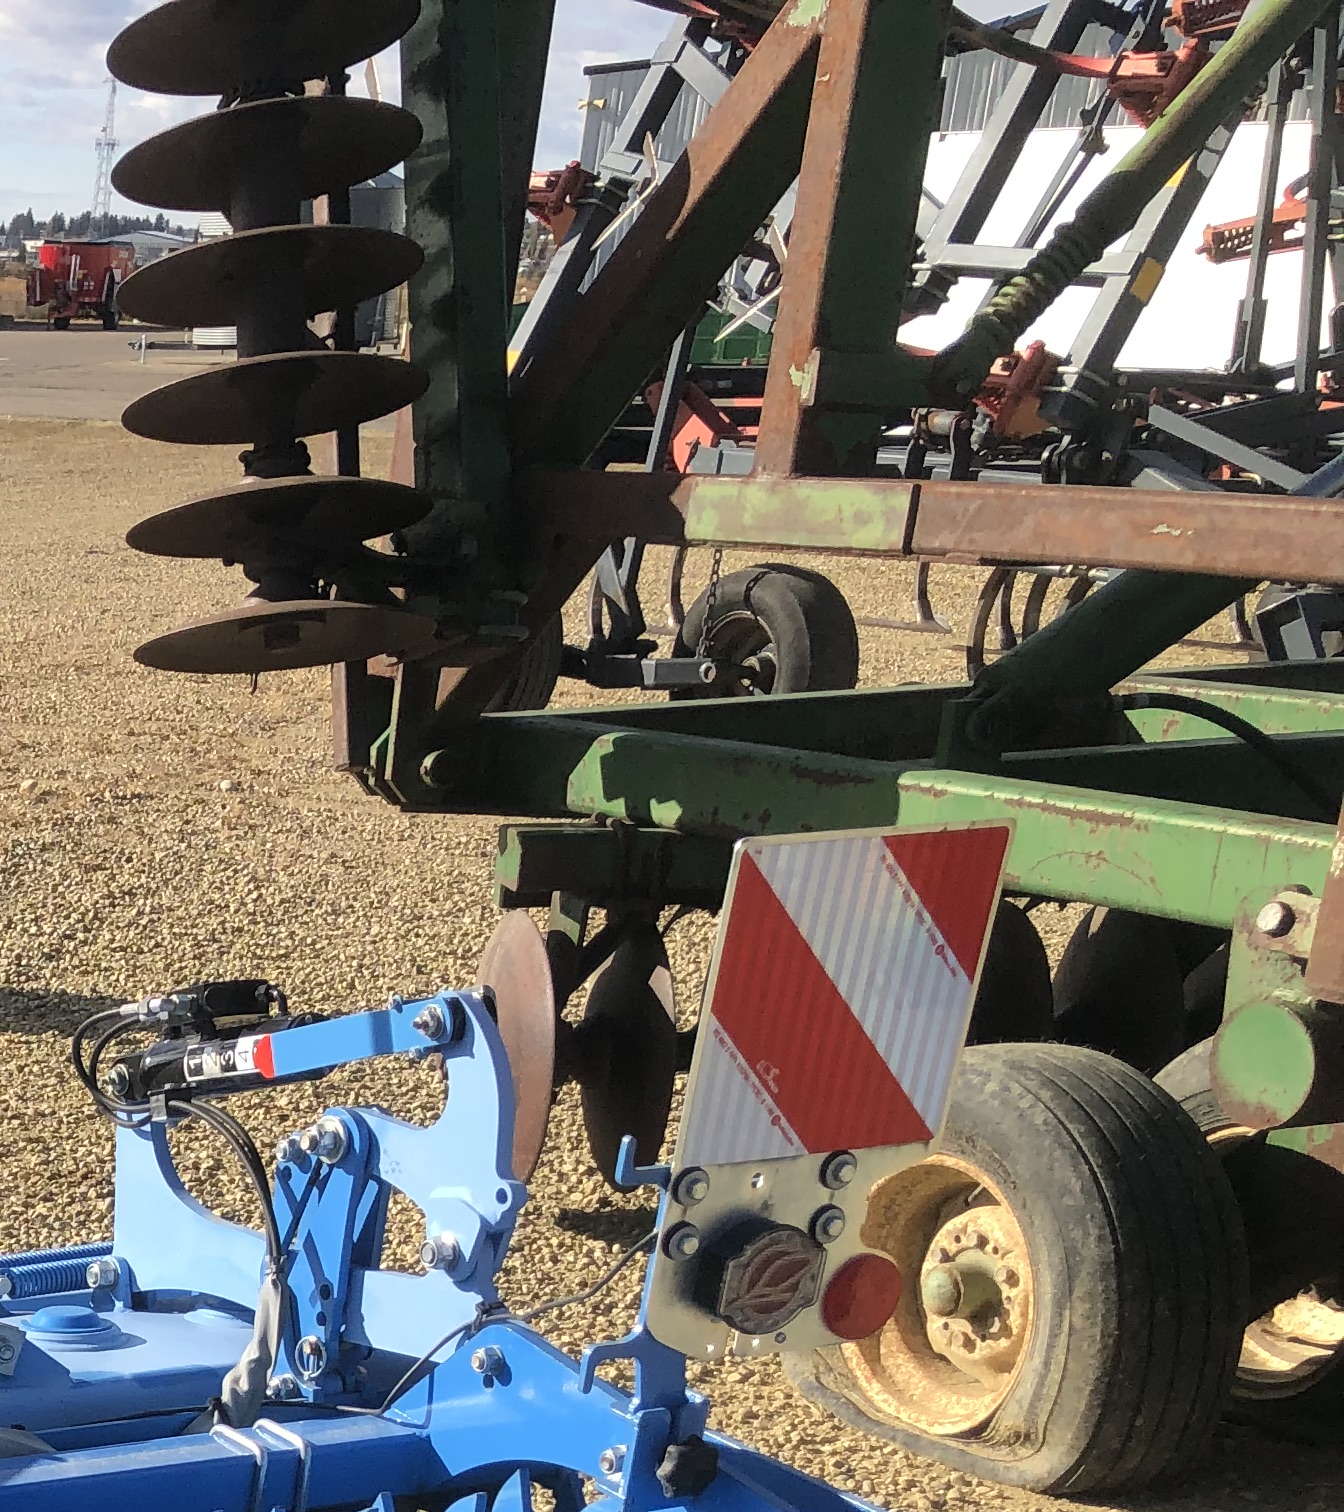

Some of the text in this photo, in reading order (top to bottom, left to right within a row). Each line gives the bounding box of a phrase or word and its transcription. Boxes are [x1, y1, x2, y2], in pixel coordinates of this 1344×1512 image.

[188, 1057, 202, 1069] 1
[221, 1049, 234, 1067] 3
[237, 1049, 250, 1063] 4
